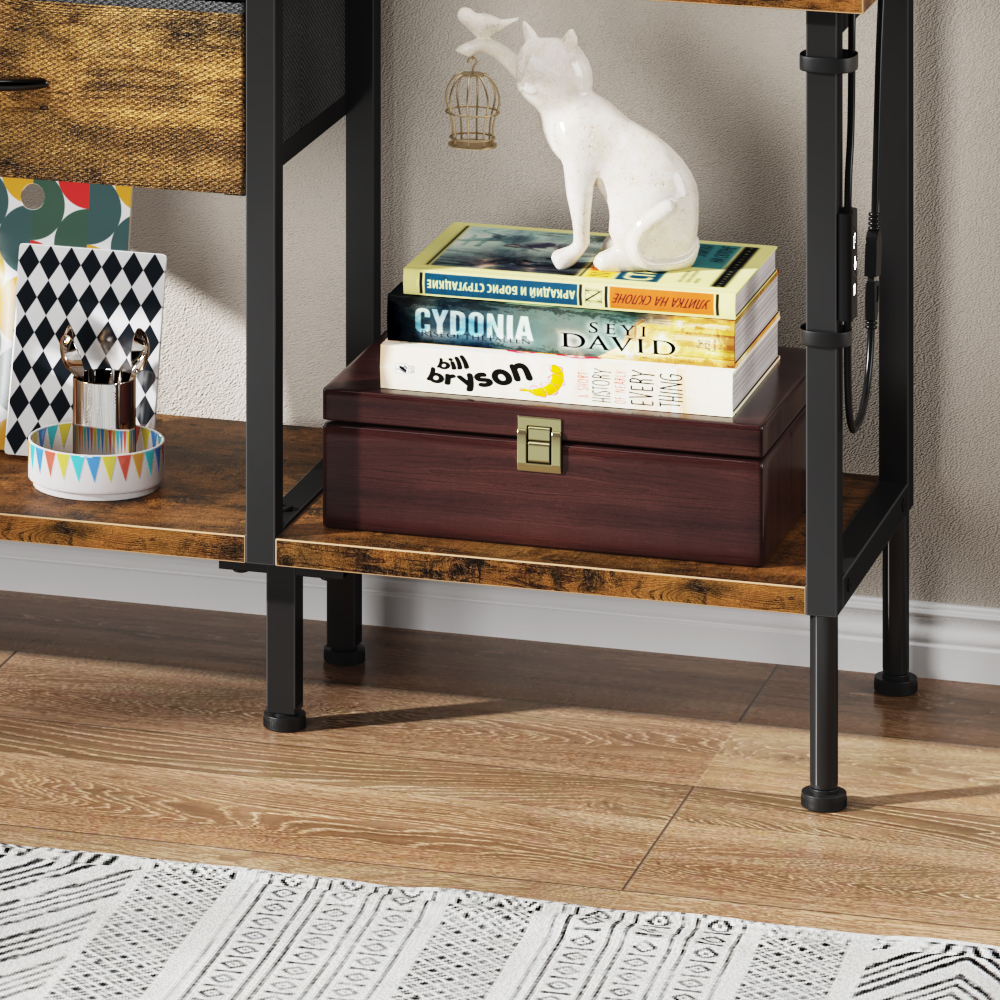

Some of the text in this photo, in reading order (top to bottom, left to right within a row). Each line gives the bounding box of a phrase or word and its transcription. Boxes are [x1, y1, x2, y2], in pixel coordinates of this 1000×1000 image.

[426, 279, 576, 302] АРКАДИЙ И БОРИС СТРУГАЦКИЕ
[612, 292, 712, 311] УЛИТКА НА СКЛОНЕ
[414, 307, 534, 341] CYDONIA
[588, 321, 647, 338] SEYI
[421, 330, 446, 338] RISE
[489, 335, 532, 345] FALLEN
[563, 331, 677, 356] DAVID
[426, 359, 533, 391] bryson
[437, 355, 470, 370] bill
[577, 371, 589, 391] SHORT
[591, 367, 611, 403] HISTORY
[614, 370, 627, 405] OF NEARLY
[629, 369, 655, 406] EVERY
[658, 373, 684, 407] THING
